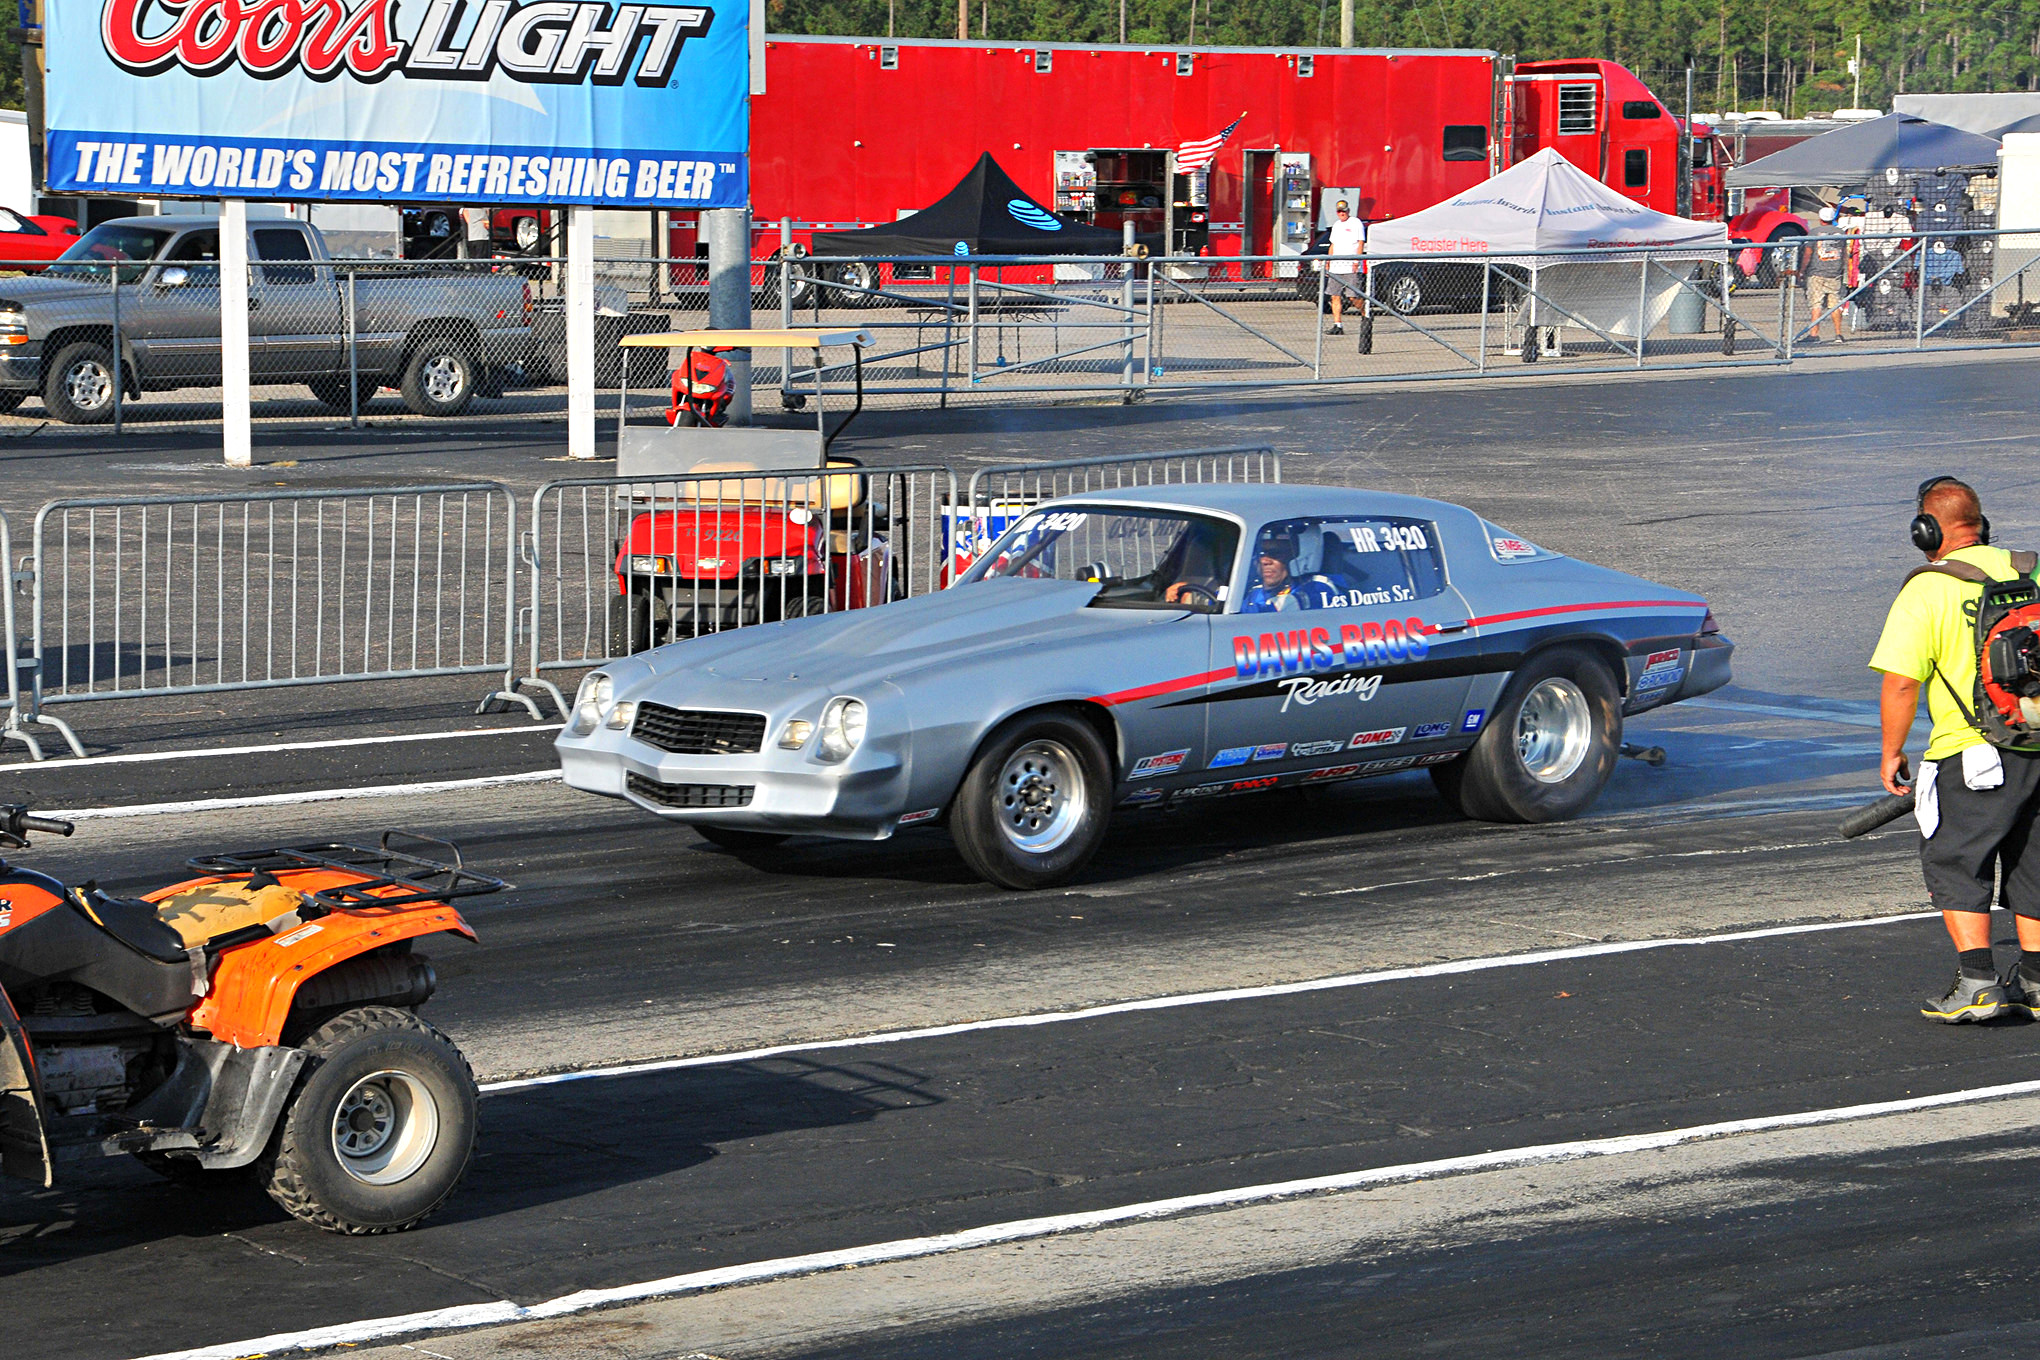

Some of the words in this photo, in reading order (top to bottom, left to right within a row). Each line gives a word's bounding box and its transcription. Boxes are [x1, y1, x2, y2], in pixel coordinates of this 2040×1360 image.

[101, 0, 411, 84] Coors
[404, 1, 715, 88] LIGHT
[75, 141, 147, 184] THE
[150, 144, 317, 191] WORLD'S
[319, 151, 425, 193] MOST
[426, 153, 630, 198] REFRESHING
[1411, 237, 1457, 252] Register
[1460, 237, 1488, 253] Here
[1038, 513, 1087, 531] 3420
[1350, 527, 1381, 553] HR
[1384, 525, 1427, 551] 3420
[1320, 591, 1347, 609] Les
[1350, 587, 1391, 607] Davis
[1392, 585, 1414, 602] Sr.
[1233, 627, 1334, 681] DAVIS
[1340, 617, 1430, 668] BROS
[1277, 673, 1383, 713] Racing
[1414, 721, 1450, 737] LONG
[1466, 714, 1480, 727] GM
[1352, 731, 1392, 746] COMP
[1308, 764, 1360, 779] ARP
